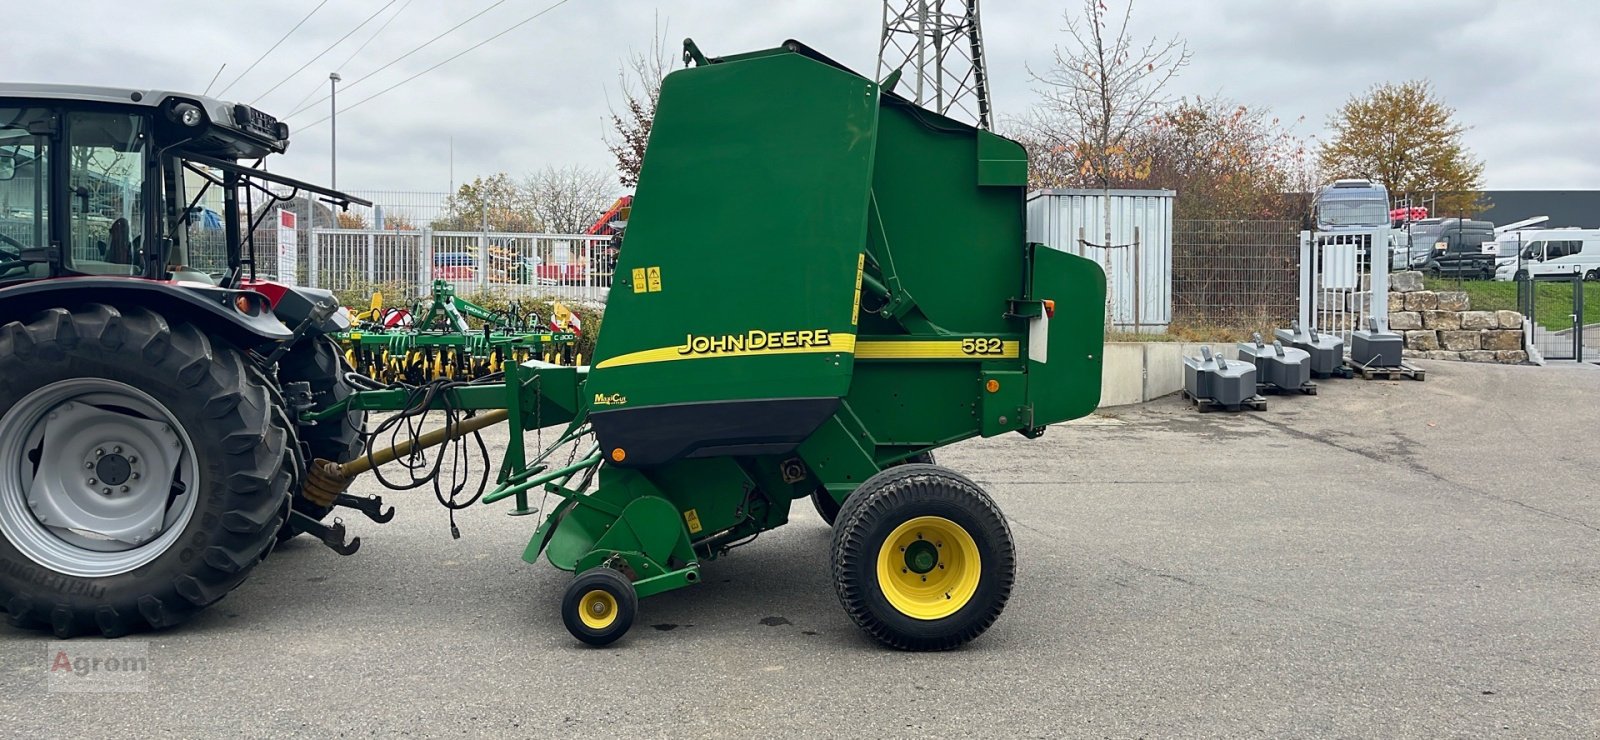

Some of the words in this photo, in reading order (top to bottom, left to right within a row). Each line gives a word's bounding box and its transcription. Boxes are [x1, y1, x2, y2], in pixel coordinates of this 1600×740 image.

[677, 334, 745, 354] JOHN
[747, 329, 831, 350] DEERE
[962, 338, 1002, 354] 582
